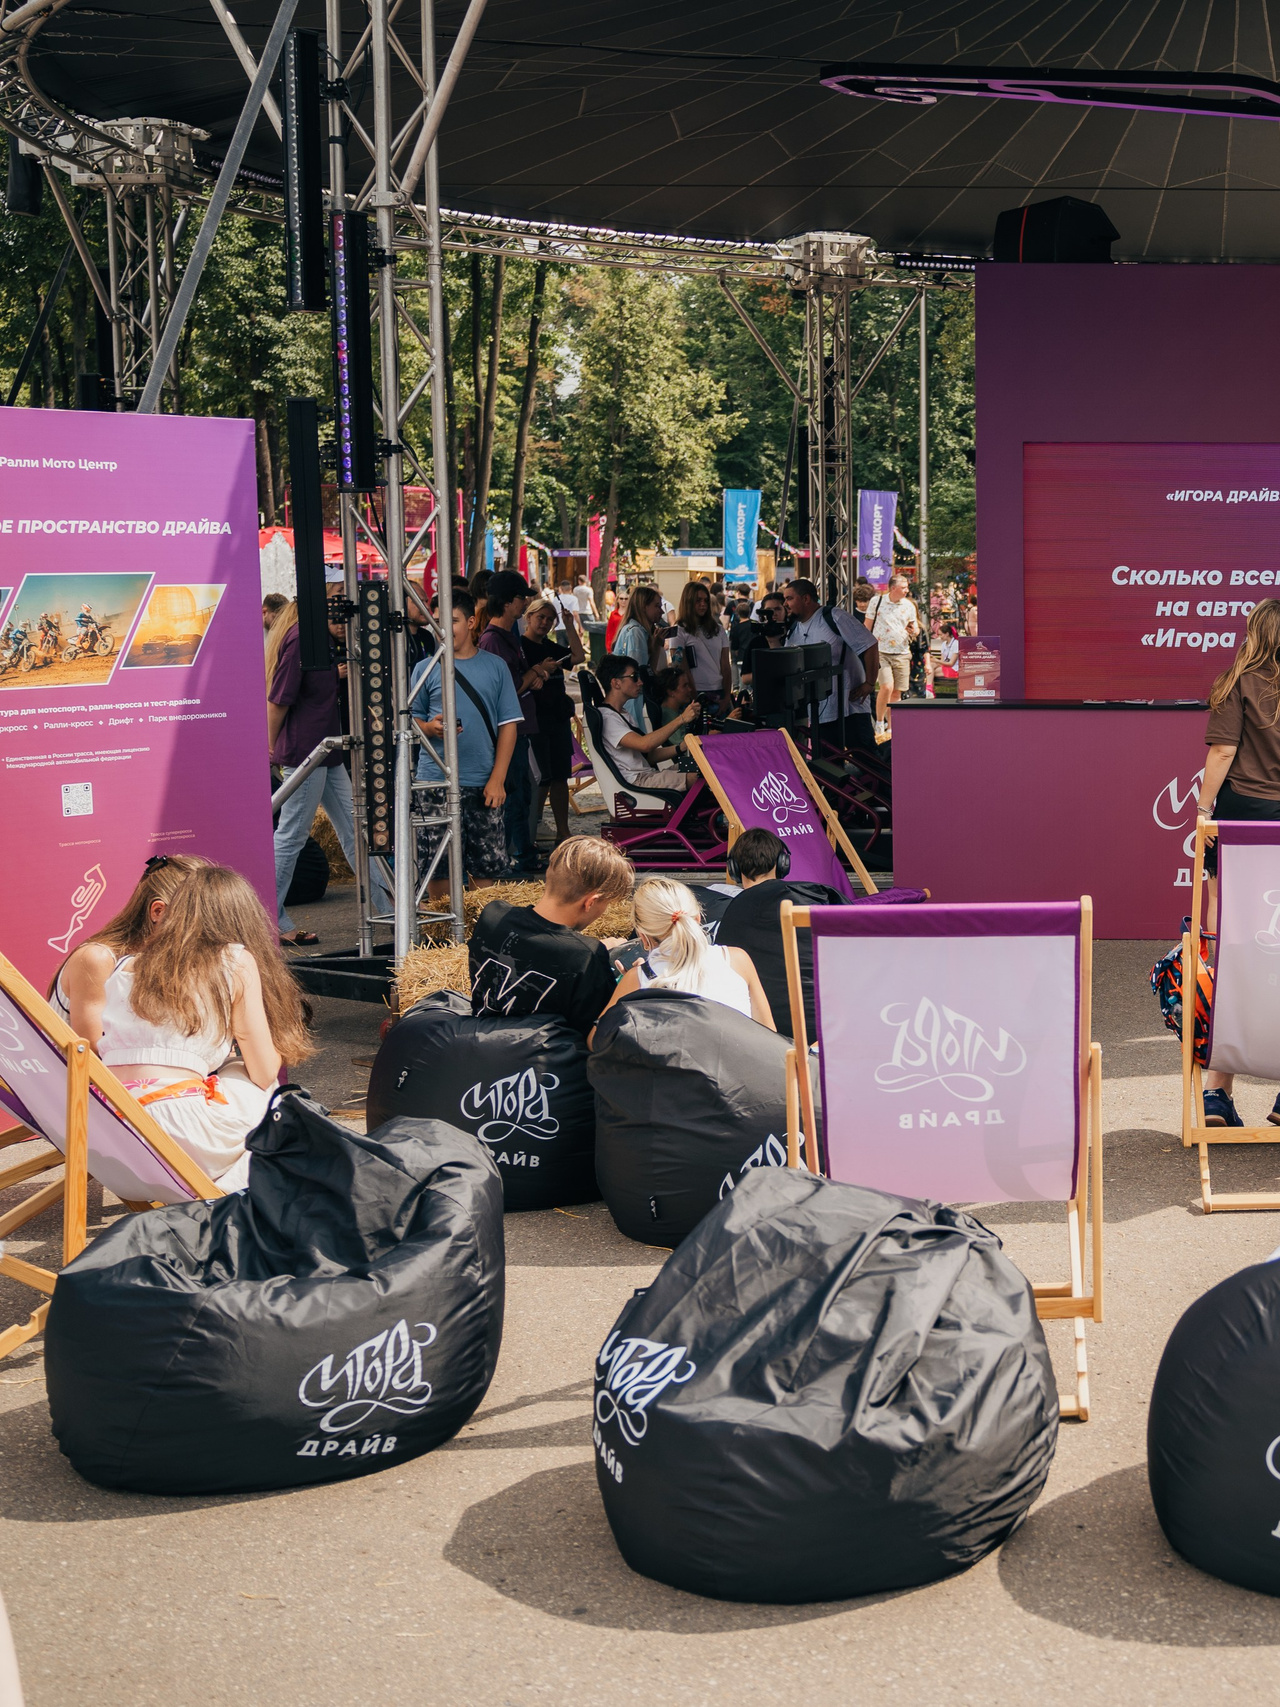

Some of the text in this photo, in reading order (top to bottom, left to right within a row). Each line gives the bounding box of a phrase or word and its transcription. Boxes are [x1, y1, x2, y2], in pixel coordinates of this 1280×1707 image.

[0, 457, 118, 472] Ралли Мото Центр
[1166, 490, 1223, 502] «ИГОРА
[0, 518, 232, 536] Е ПРОСТРАНСТВО ДРАЙВА
[736, 502, 747, 556] ФУДКОРТ
[872, 504, 883, 557] ФУДКОРТ
[1111, 565, 1223, 586] Сколько
[1155, 601, 1189, 617] на
[1140, 627, 1236, 652] «Игора
[20, 708, 36, 716] для
[38, 705, 88, 714] мотоспорта,
[88, 701, 143, 712] ралли-кросса
[150, 698, 201, 707] тест-драйвов
[43, 720, 94, 730] Ралли-кросс
[108, 717, 134, 727] Дрифт
[148, 715, 168, 724] Парк
[168, 712, 227, 721] внедорожников
[777, 823, 814, 837] ДРАЙВ
[488, 1149, 540, 1168] АЙВ
[296, 1434, 398, 1457] ДРАЙВ
